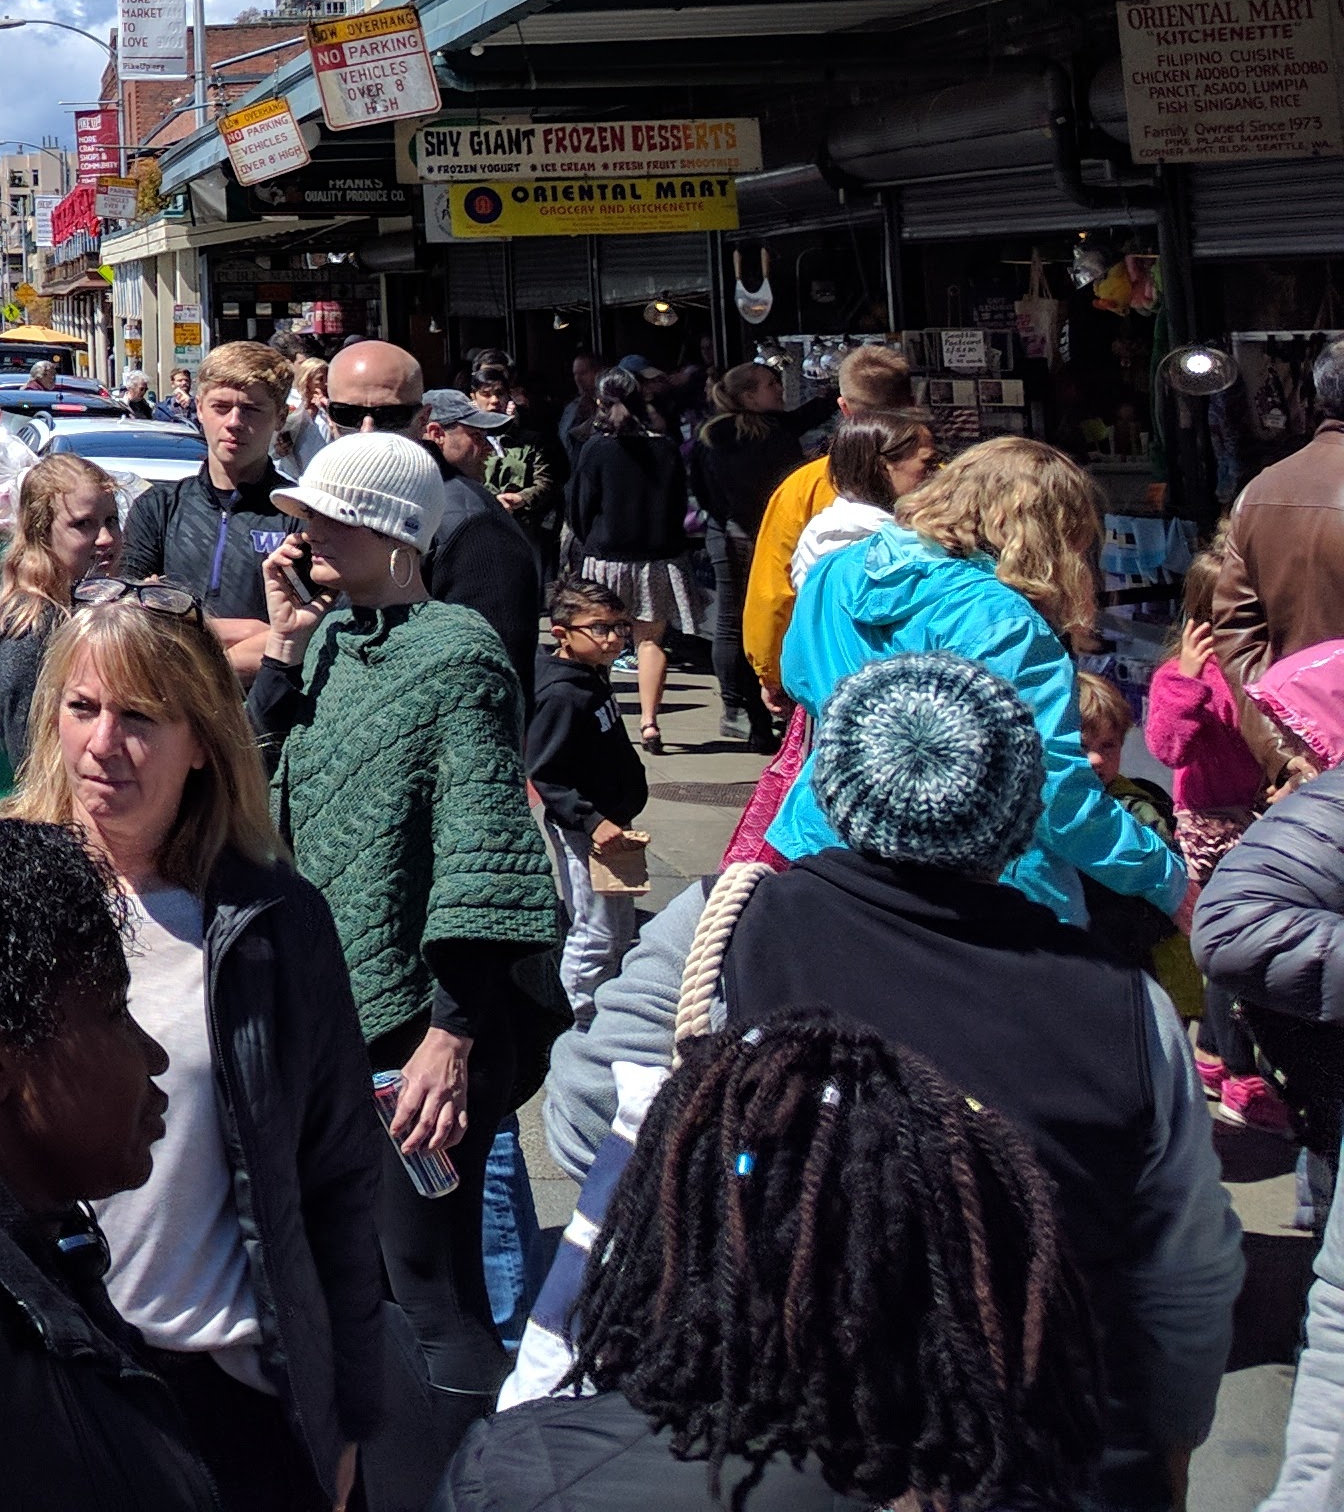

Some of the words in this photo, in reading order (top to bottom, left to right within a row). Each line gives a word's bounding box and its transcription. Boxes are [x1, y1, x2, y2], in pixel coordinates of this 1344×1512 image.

[122, 8, 163, 19] MARKET
[1127, 0, 1239, 30] ORIENTAL
[122, 22, 136, 33] TO
[347, 13, 415, 36] OVERHANG
[122, 36, 148, 48] LOVE
[317, 49, 341, 66] NO
[348, 34, 418, 60] PARKING
[1157, 51, 1223, 67] FILIPINO
[1230, 47, 1295, 63] CUISINE
[339, 61, 408, 84] VEHICLES
[1132, 70, 1190, 85] CHICKEN
[1283, 60, 1328, 75] ADOBO
[347, 82, 384, 101] OVER
[1253, 78, 1309, 93] LUMPIA
[244, 101, 285, 123] OVERHANG
[1157, 100, 1188, 114] FISH
[1270, 94, 1301, 108] RICE
[226, 130, 243, 143] NO
[246, 115, 289, 138] PARKING
[1144, 124, 1189, 139] Family
[1194, 121, 1245, 135] Owned
[1249, 119, 1286, 133] Since
[1288, 116, 1323, 131] 1973
[240, 132, 288, 156] VEHICLES
[423, 129, 461, 158] SHY
[469, 127, 535, 156] GIANT
[542, 124, 625, 155] FROZEN
[631, 122, 738, 152] DESSERTS
[1197, 135, 1234, 145] PLACE
[1240, 132, 1296, 143] MARKET
[240, 158, 266, 175] OVER
[277, 144, 303, 161] HIGH
[1139, 147, 1184, 159] CORNER
[80, 161, 119, 170] COMMUNITY
[437, 163, 477, 174] FROZEN
[480, 163, 521, 174] YOGURT
[541, 164, 557, 173] ICE
[560, 161, 596, 172] CREAM
[612, 161, 644, 171] FRESH
[646, 159, 677, 170] FRUIT
[304, 190, 343, 202] QUALITY
[346, 190, 388, 202] PRODUCE
[391, 190, 406, 201] CO.
[511, 184, 641, 204] ORIENTAL
[655, 180, 730, 200] MART
[539, 204, 595, 216] GROCERY
[599, 204, 625, 214] AND
[628, 201, 705, 213] KITCHENETTE
[249, 528, 287, 554] W
